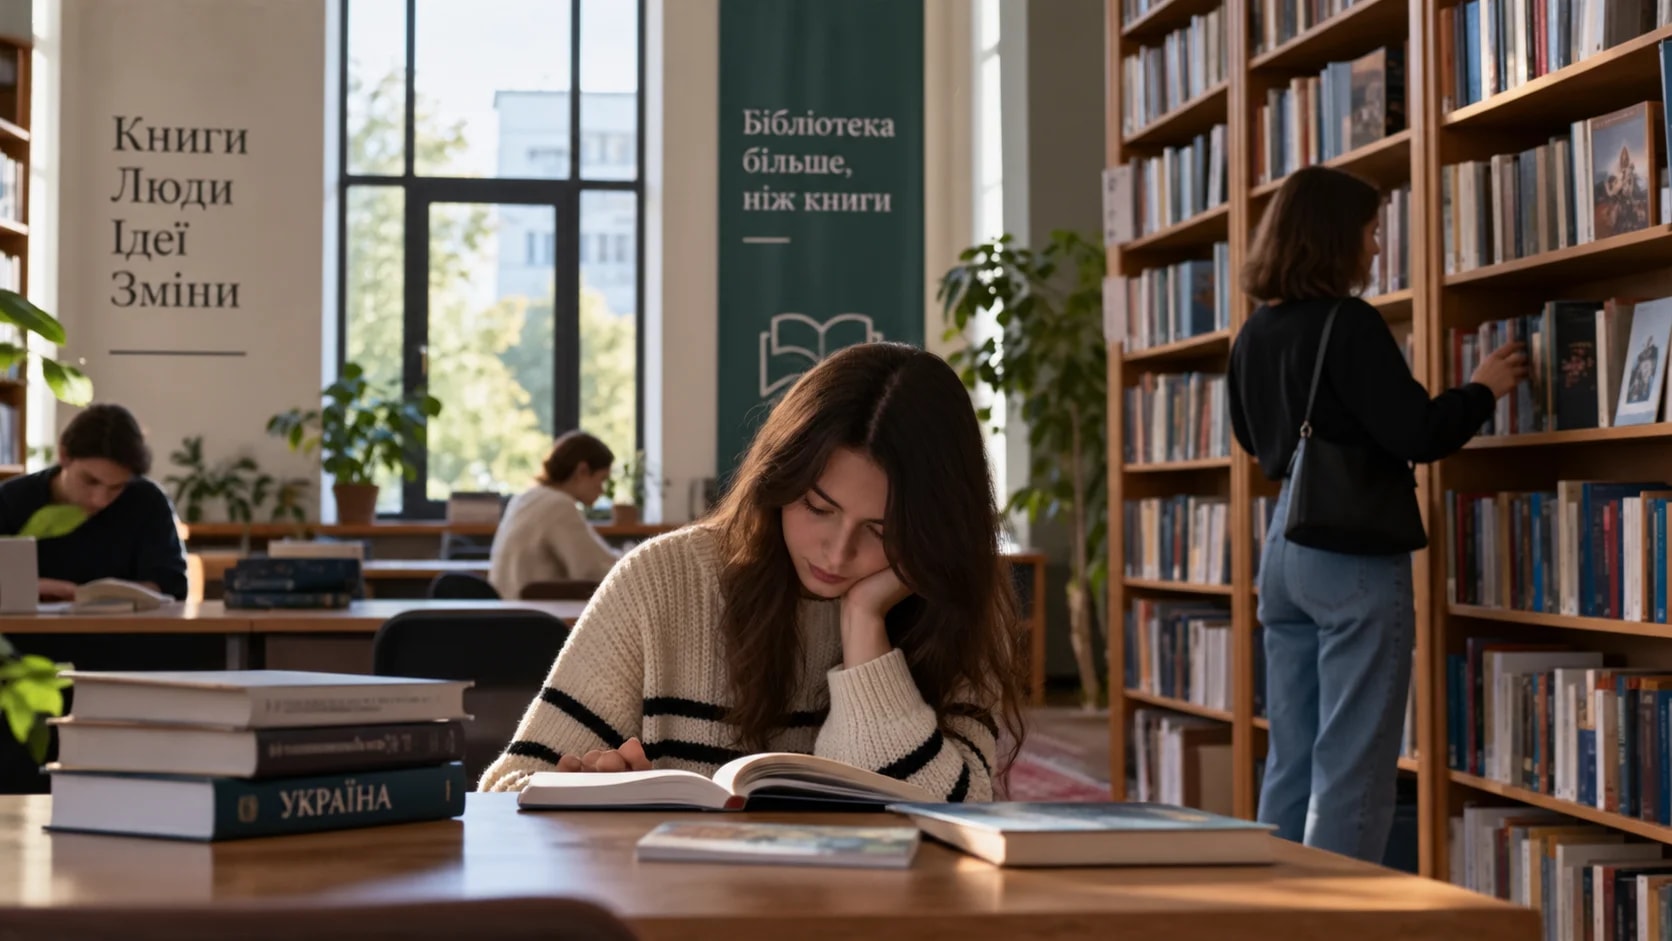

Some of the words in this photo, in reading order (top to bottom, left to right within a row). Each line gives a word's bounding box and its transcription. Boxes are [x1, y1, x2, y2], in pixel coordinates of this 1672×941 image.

[112, 116, 248, 154] Книги
[743, 109, 894, 137] Бібліотека
[743, 148, 852, 177] більше,
[111, 167, 233, 209] Люди
[743, 186, 795, 211] ніж
[804, 192, 891, 212] книги
[111, 220, 189, 260] Ідеї
[111, 271, 240, 308] Зміни
[280, 780, 391, 818] УКРАЇНА
